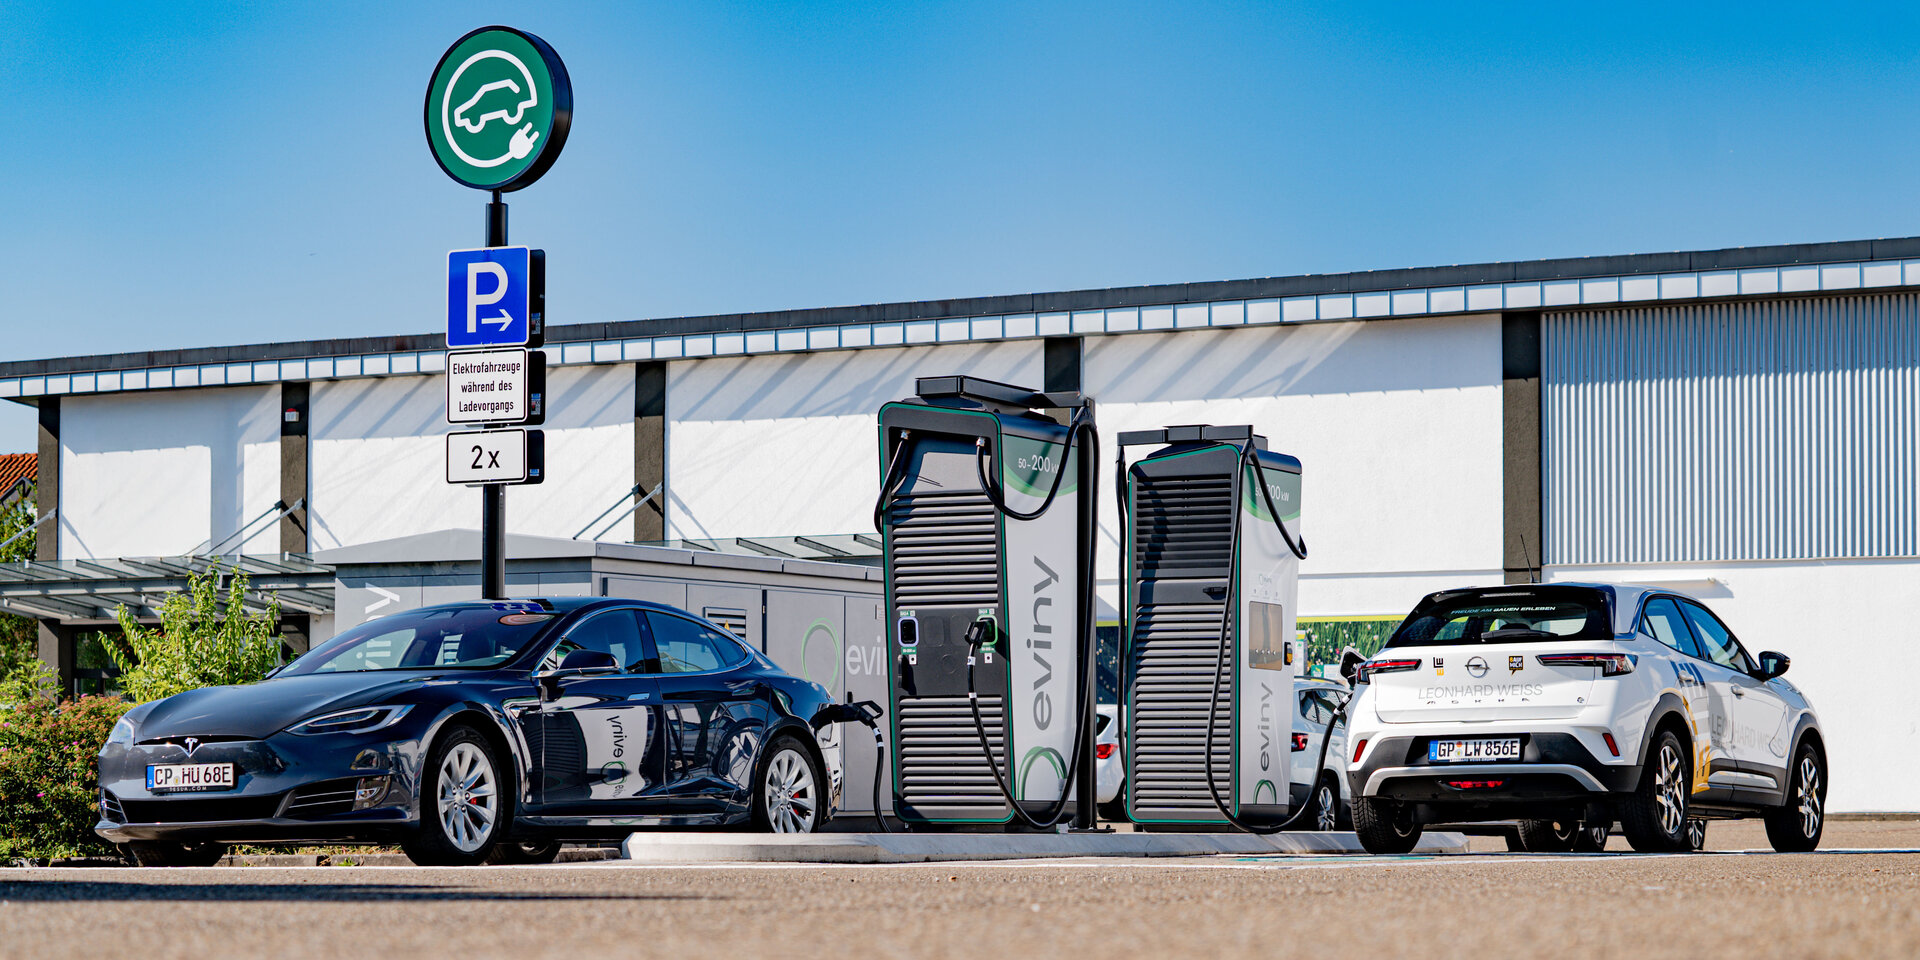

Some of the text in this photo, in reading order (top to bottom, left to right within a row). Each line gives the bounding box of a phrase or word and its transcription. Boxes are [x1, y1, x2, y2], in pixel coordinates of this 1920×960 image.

[466, 261, 508, 333] P
[453, 362, 521, 375] Elektrofahrzeuge
[461, 380, 513, 393] während des
[459, 400, 514, 414] Ladevorgangs
[471, 445, 500, 469] 2 x
[1026, 555, 1059, 731] eviny
[846, 635, 888, 676] evi
[1418, 683, 1543, 699] LEONHARD WEISS
[1257, 682, 1273, 771] eviny
[1438, 742, 1455, 757] GP
[1464, 741, 1482, 757] LW
[1485, 740, 1518, 756] 856E
[203, 766, 232, 783] 68E
